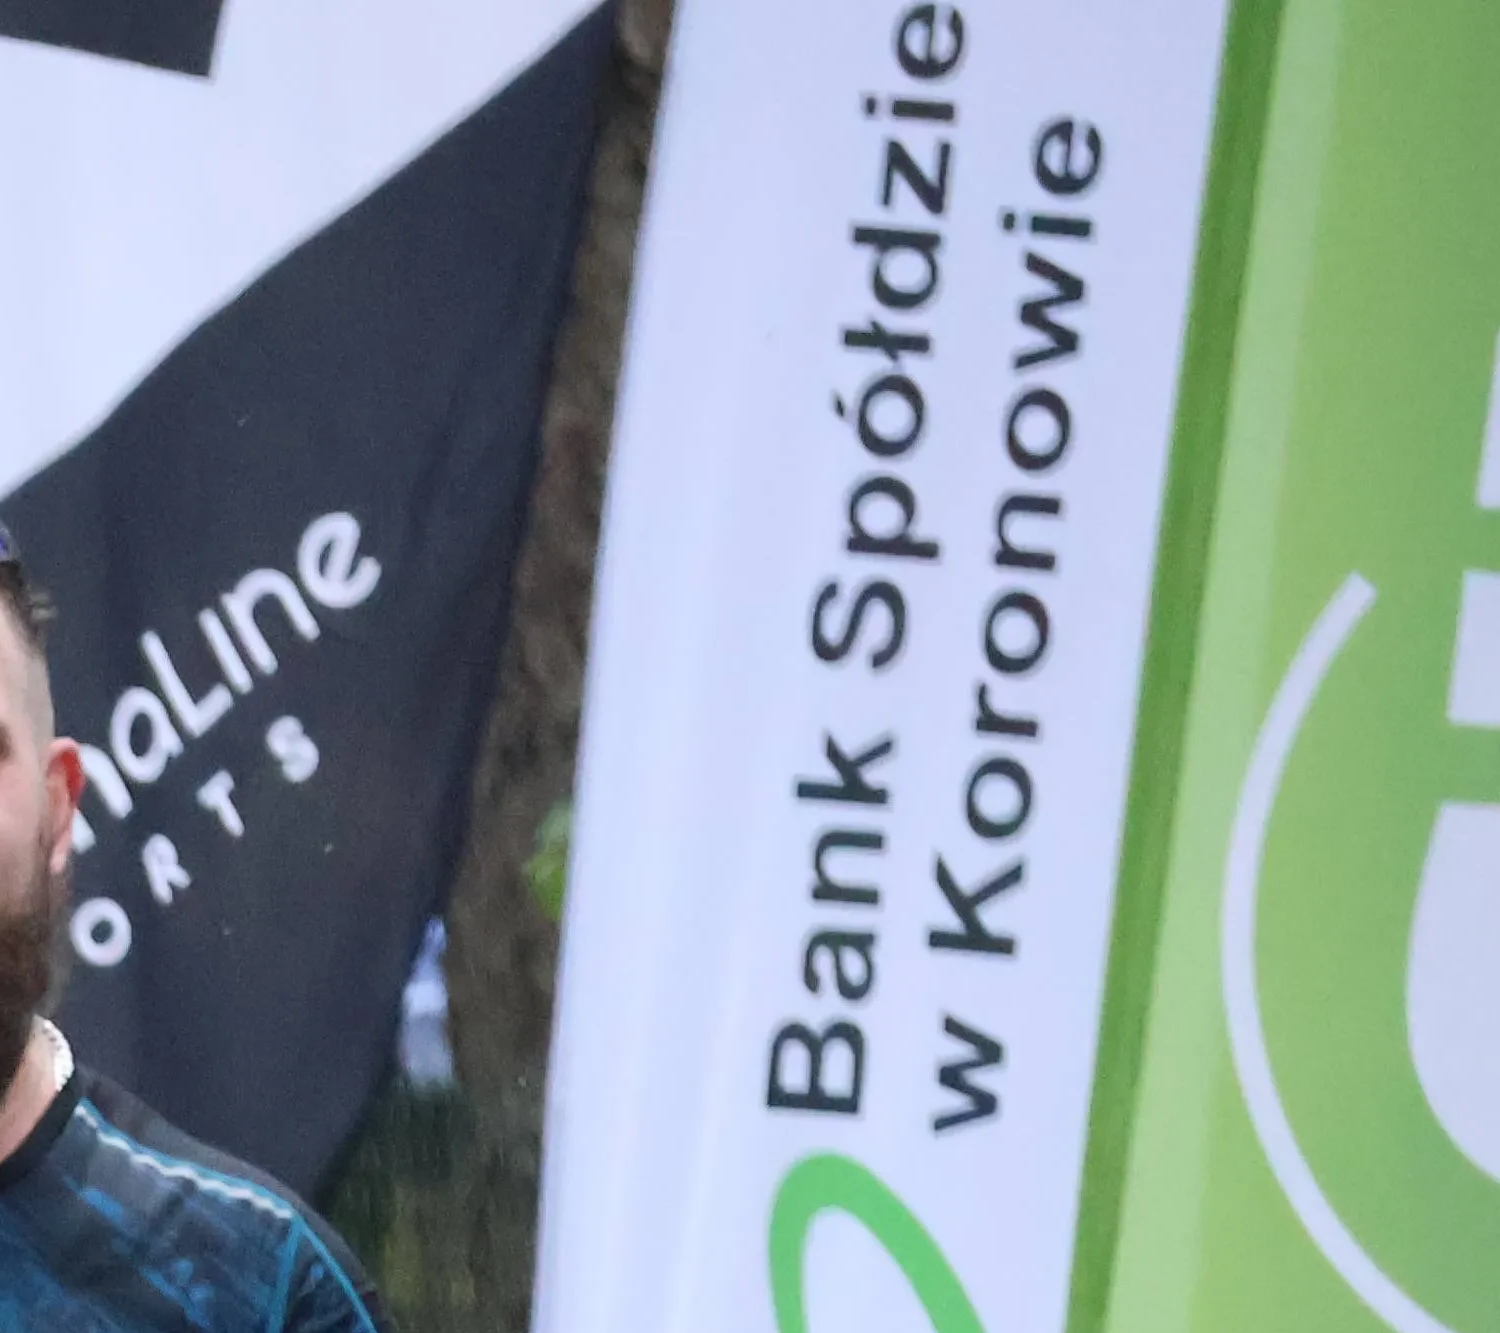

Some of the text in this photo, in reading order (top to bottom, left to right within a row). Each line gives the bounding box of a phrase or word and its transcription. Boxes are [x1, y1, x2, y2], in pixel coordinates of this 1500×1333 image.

[765, 3, 966, 1114] Bank Spółdzie
[928, 119, 1104, 1132] w Koronowie
